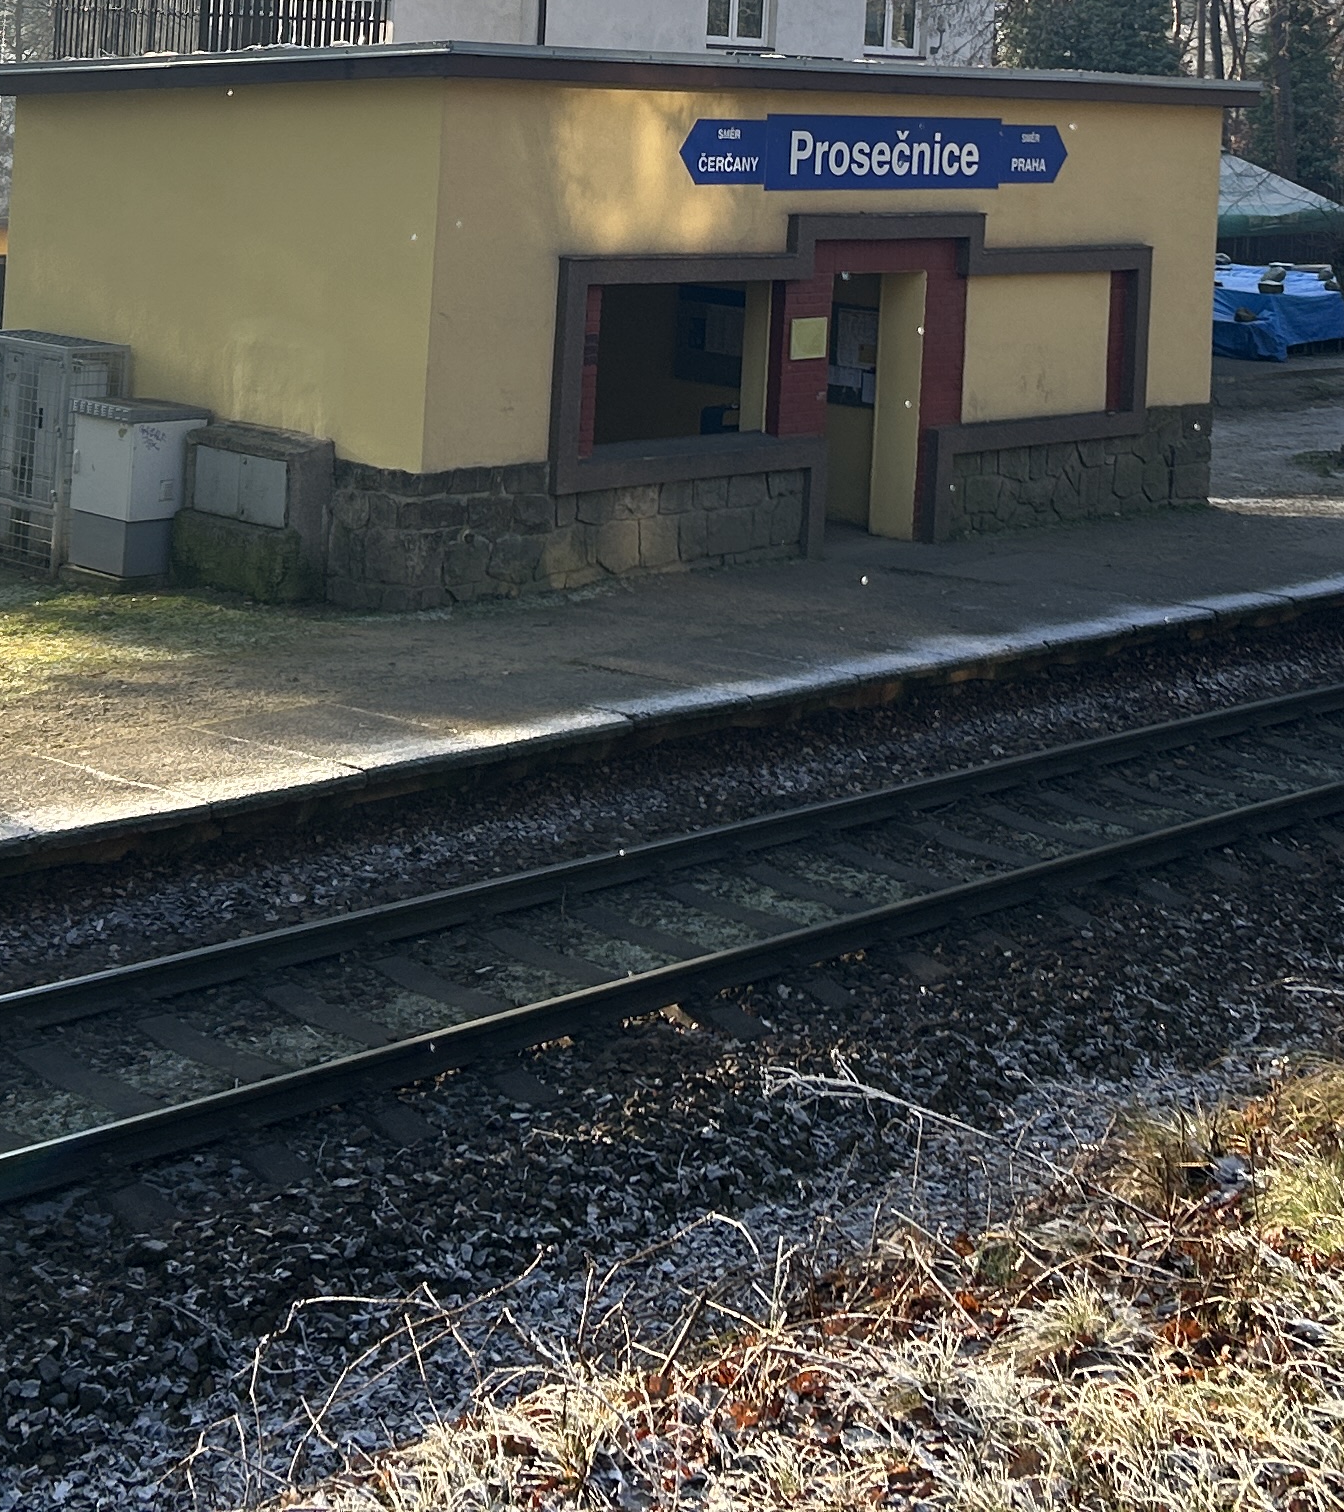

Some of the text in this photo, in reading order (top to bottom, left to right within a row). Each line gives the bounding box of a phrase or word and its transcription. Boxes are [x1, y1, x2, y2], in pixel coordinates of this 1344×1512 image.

[698, 152, 759, 172] ČERČANY
[789, 130, 980, 176] Prosečnice
[1011, 157, 1047, 172] PRAHA
